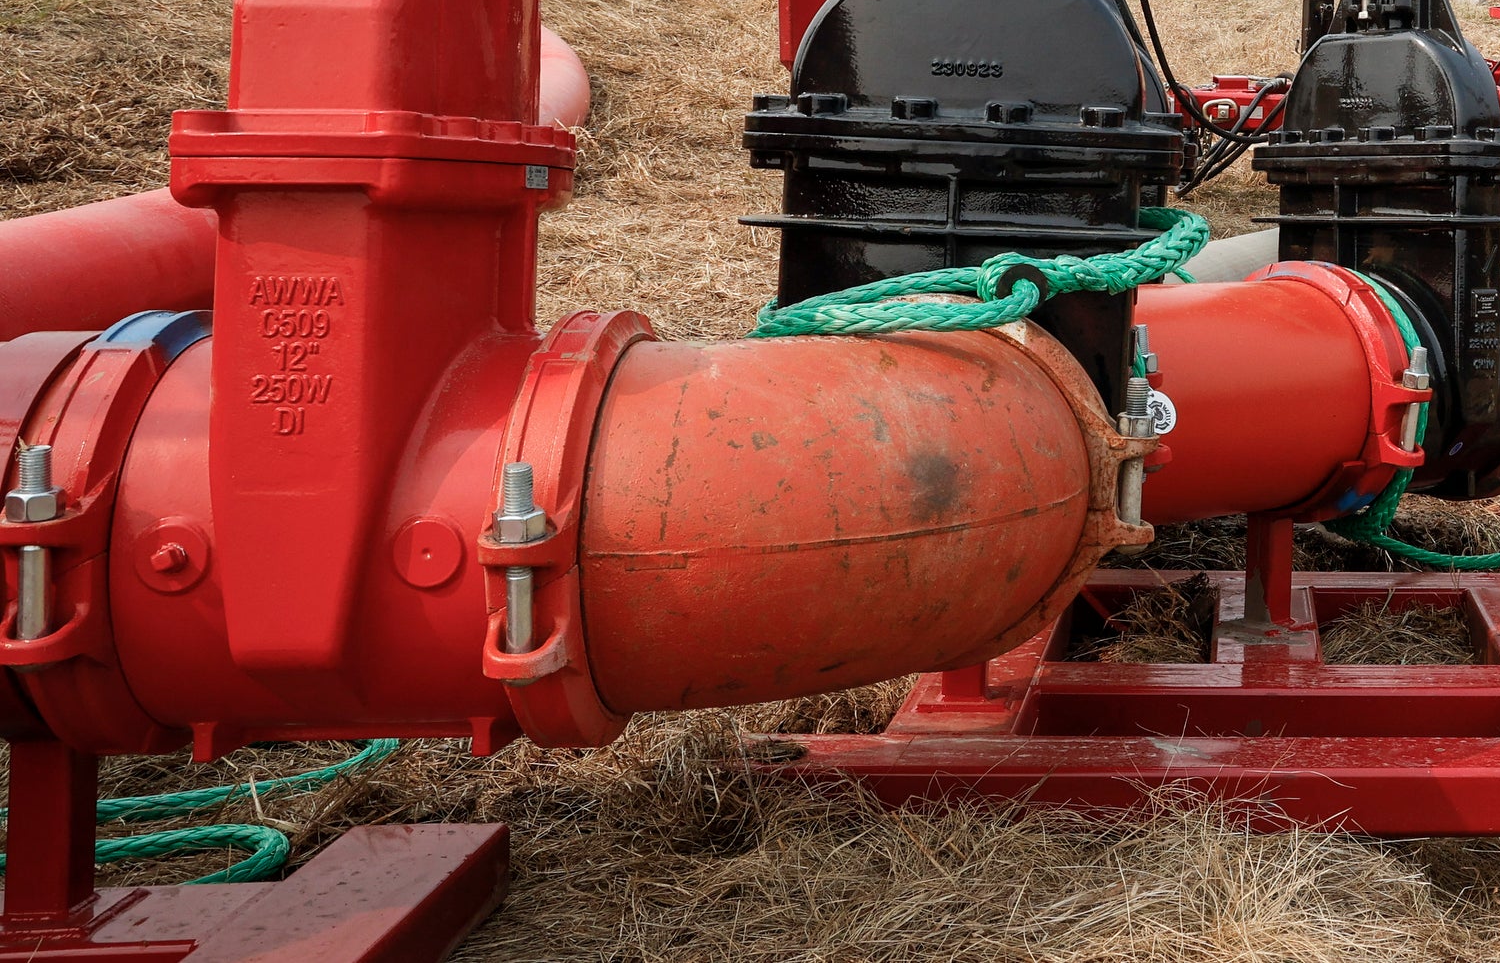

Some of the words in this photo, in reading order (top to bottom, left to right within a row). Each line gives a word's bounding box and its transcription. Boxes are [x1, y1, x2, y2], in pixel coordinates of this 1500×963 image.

[250, 275, 344, 306] AWWA
[262, 309, 331, 339] C509
[272, 341, 320, 372] 12"
[251, 374, 333, 404] 250W
[274, 406, 305, 436] DI
